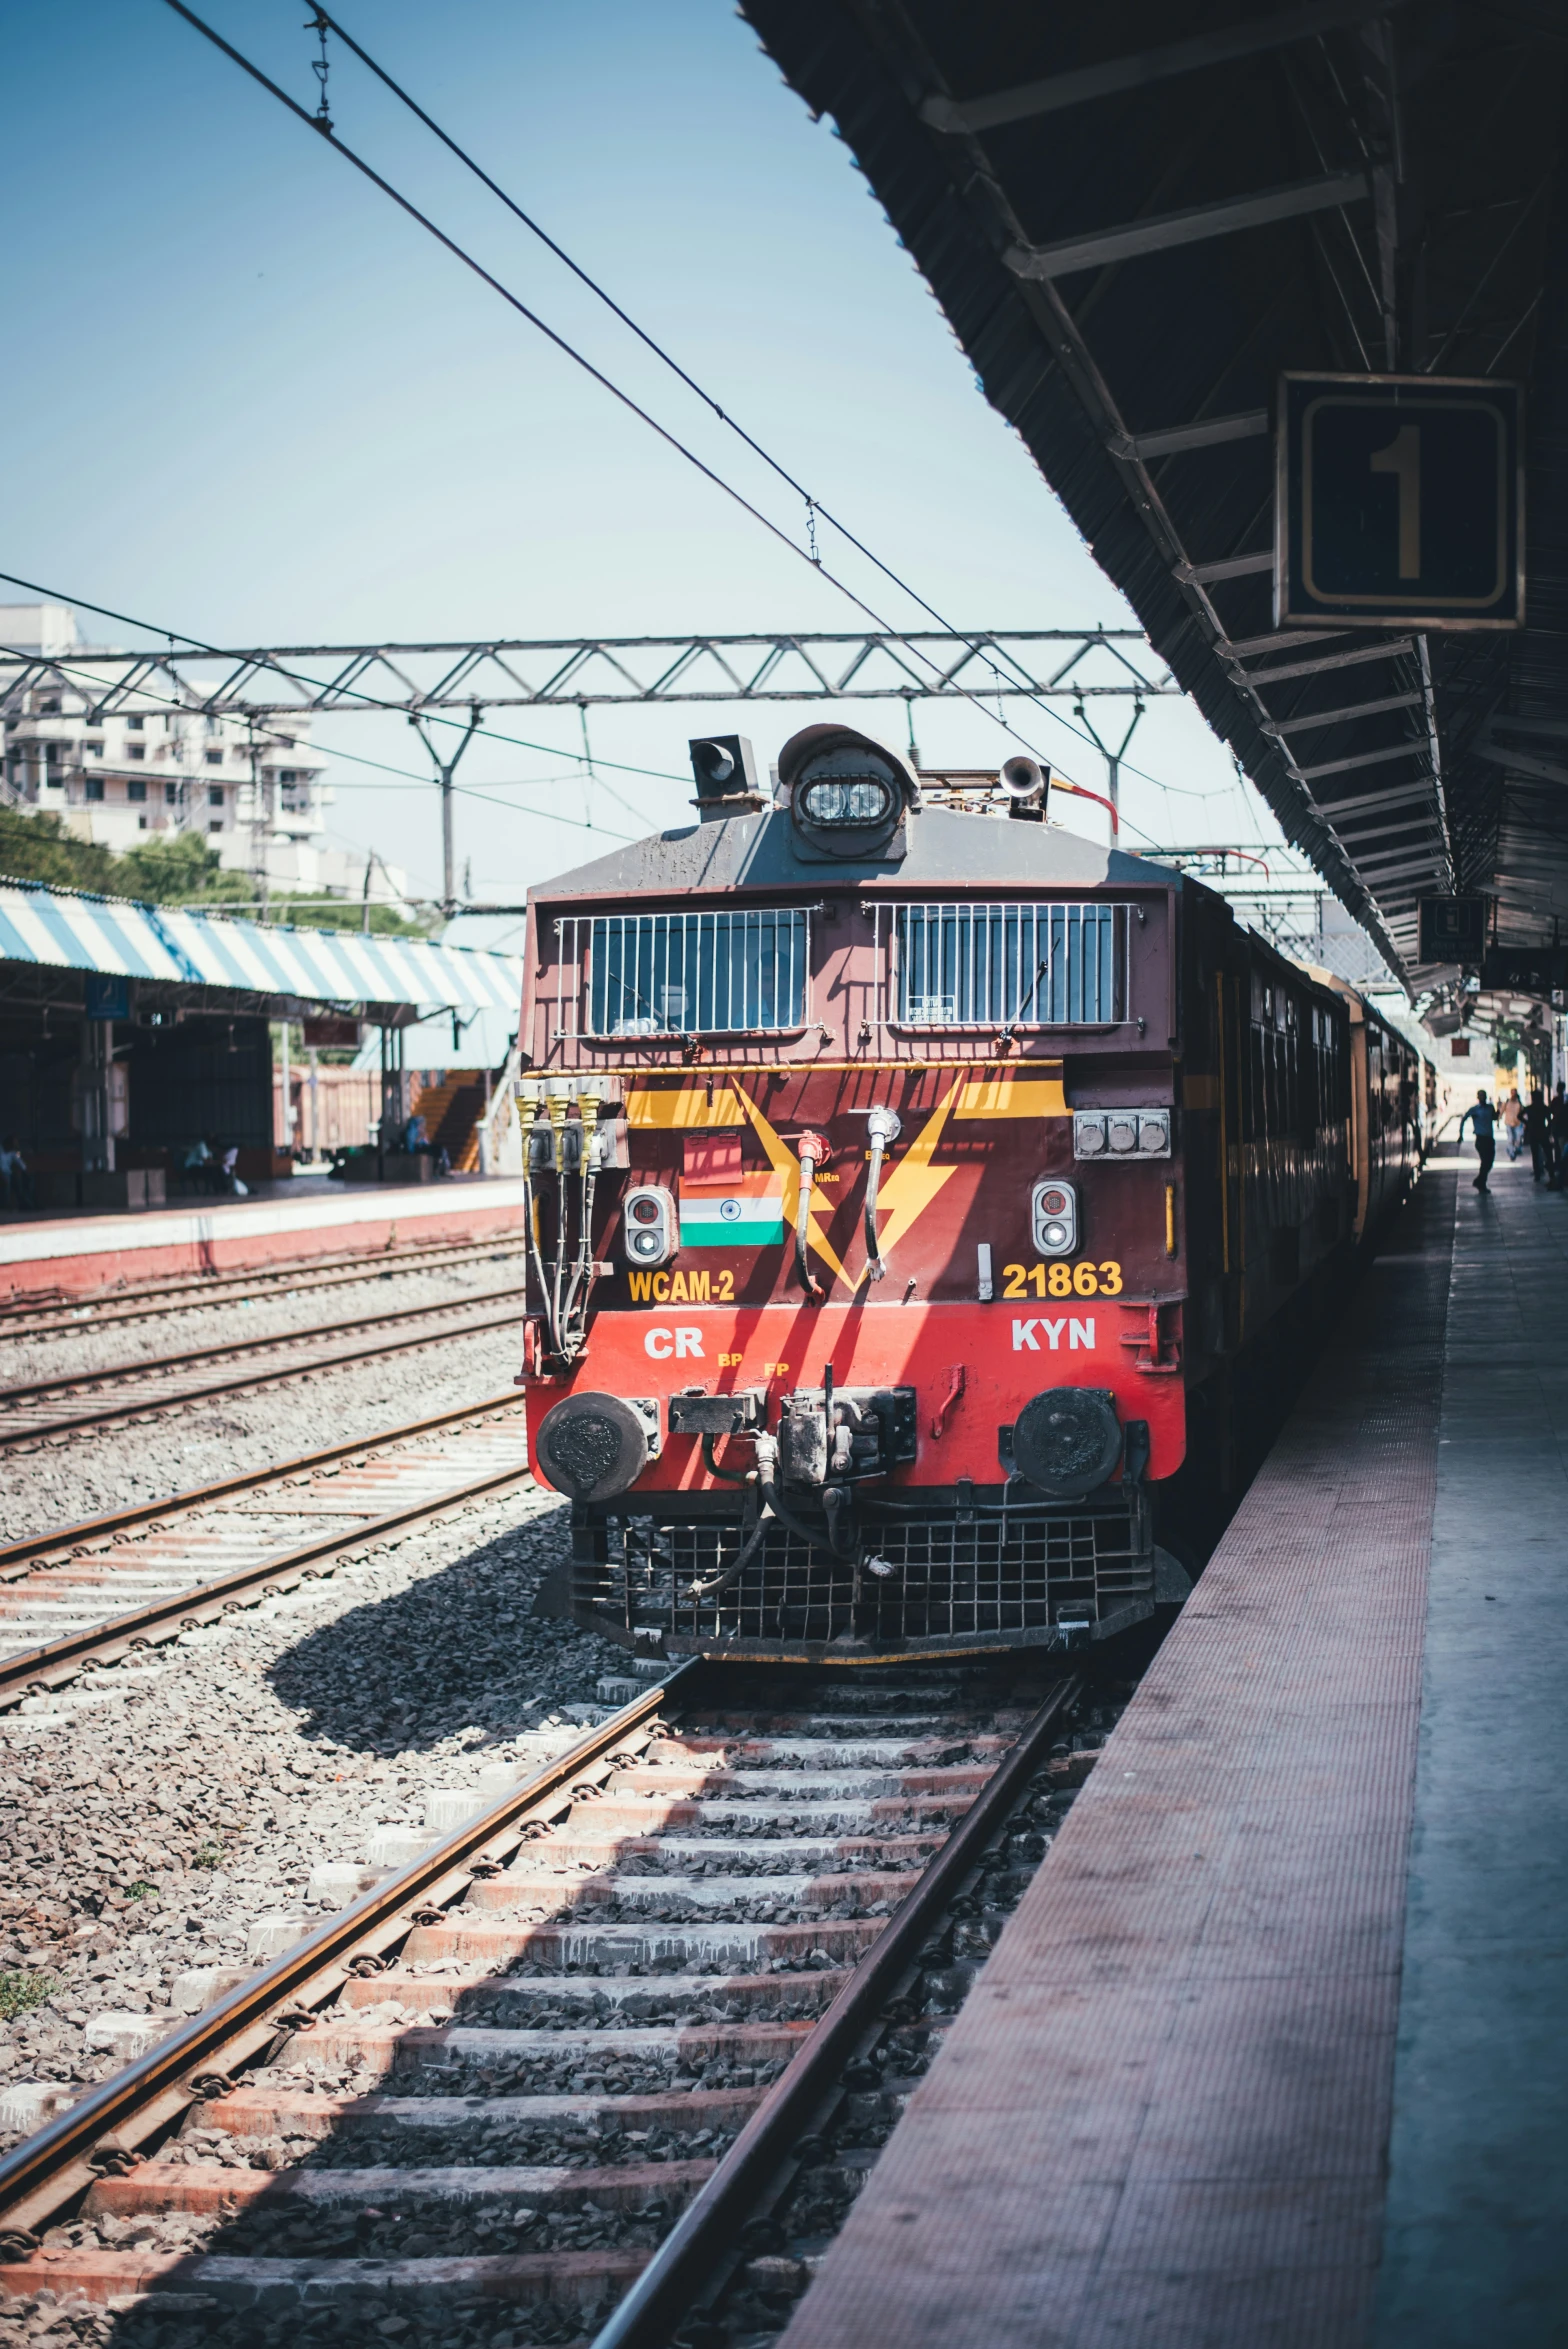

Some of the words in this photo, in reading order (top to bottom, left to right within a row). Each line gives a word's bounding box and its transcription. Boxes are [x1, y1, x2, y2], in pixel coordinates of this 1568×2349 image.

[1370, 424, 1420, 580] 1
[865, 1150, 891, 1160] BEQ
[628, 1270, 735, 1302] WCAM-2
[1002, 1261, 1123, 1299] 21863
[644, 1327, 706, 1359] CR
[1011, 1317, 1096, 1351] KYN
[718, 1353, 743, 1367] BP
[764, 1363, 790, 1377] FP
